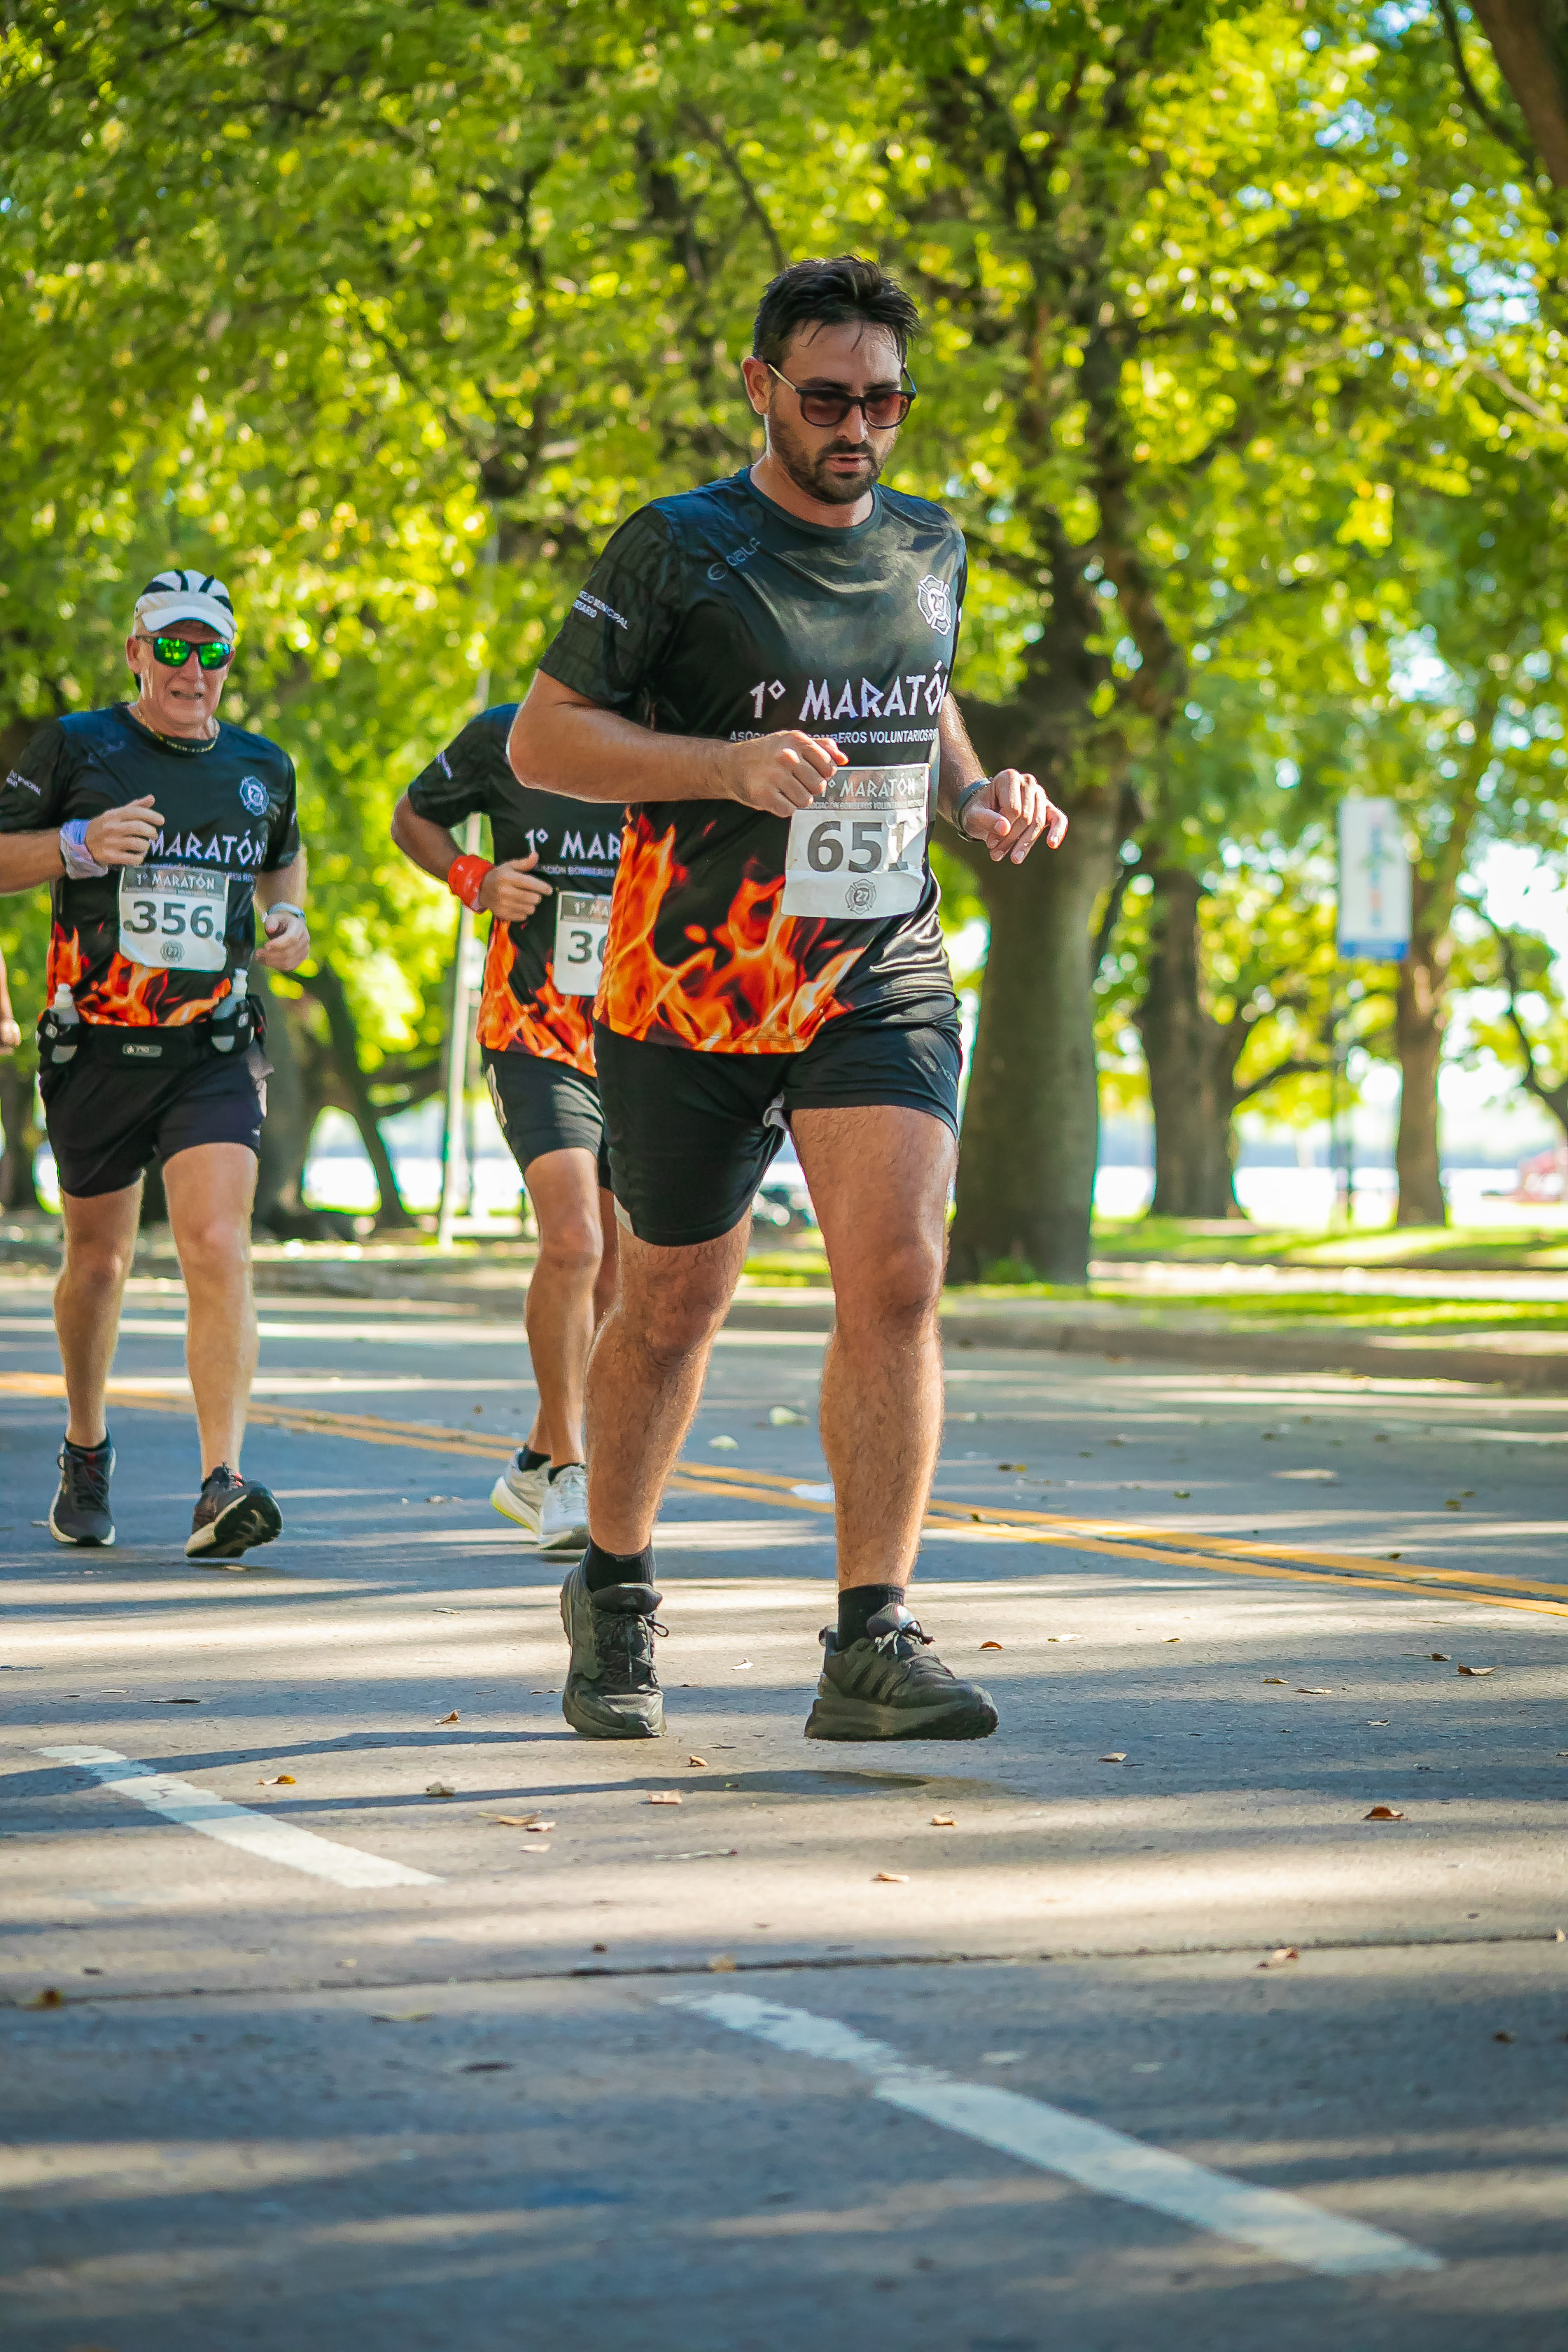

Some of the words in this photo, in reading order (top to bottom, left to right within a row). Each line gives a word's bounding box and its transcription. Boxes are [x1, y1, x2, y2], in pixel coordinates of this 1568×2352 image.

[807, 731, 867, 743] BEROS
[869, 729, 929, 743] VOLUNTARIOS
[839, 772, 916, 798] MARATÓN
[148, 829, 265, 867] MARATÓN
[807, 820, 909, 873] 651
[152, 872, 215, 890] MARATÓN
[855, 889, 869, 902] 27
[132, 900, 214, 939] 356
